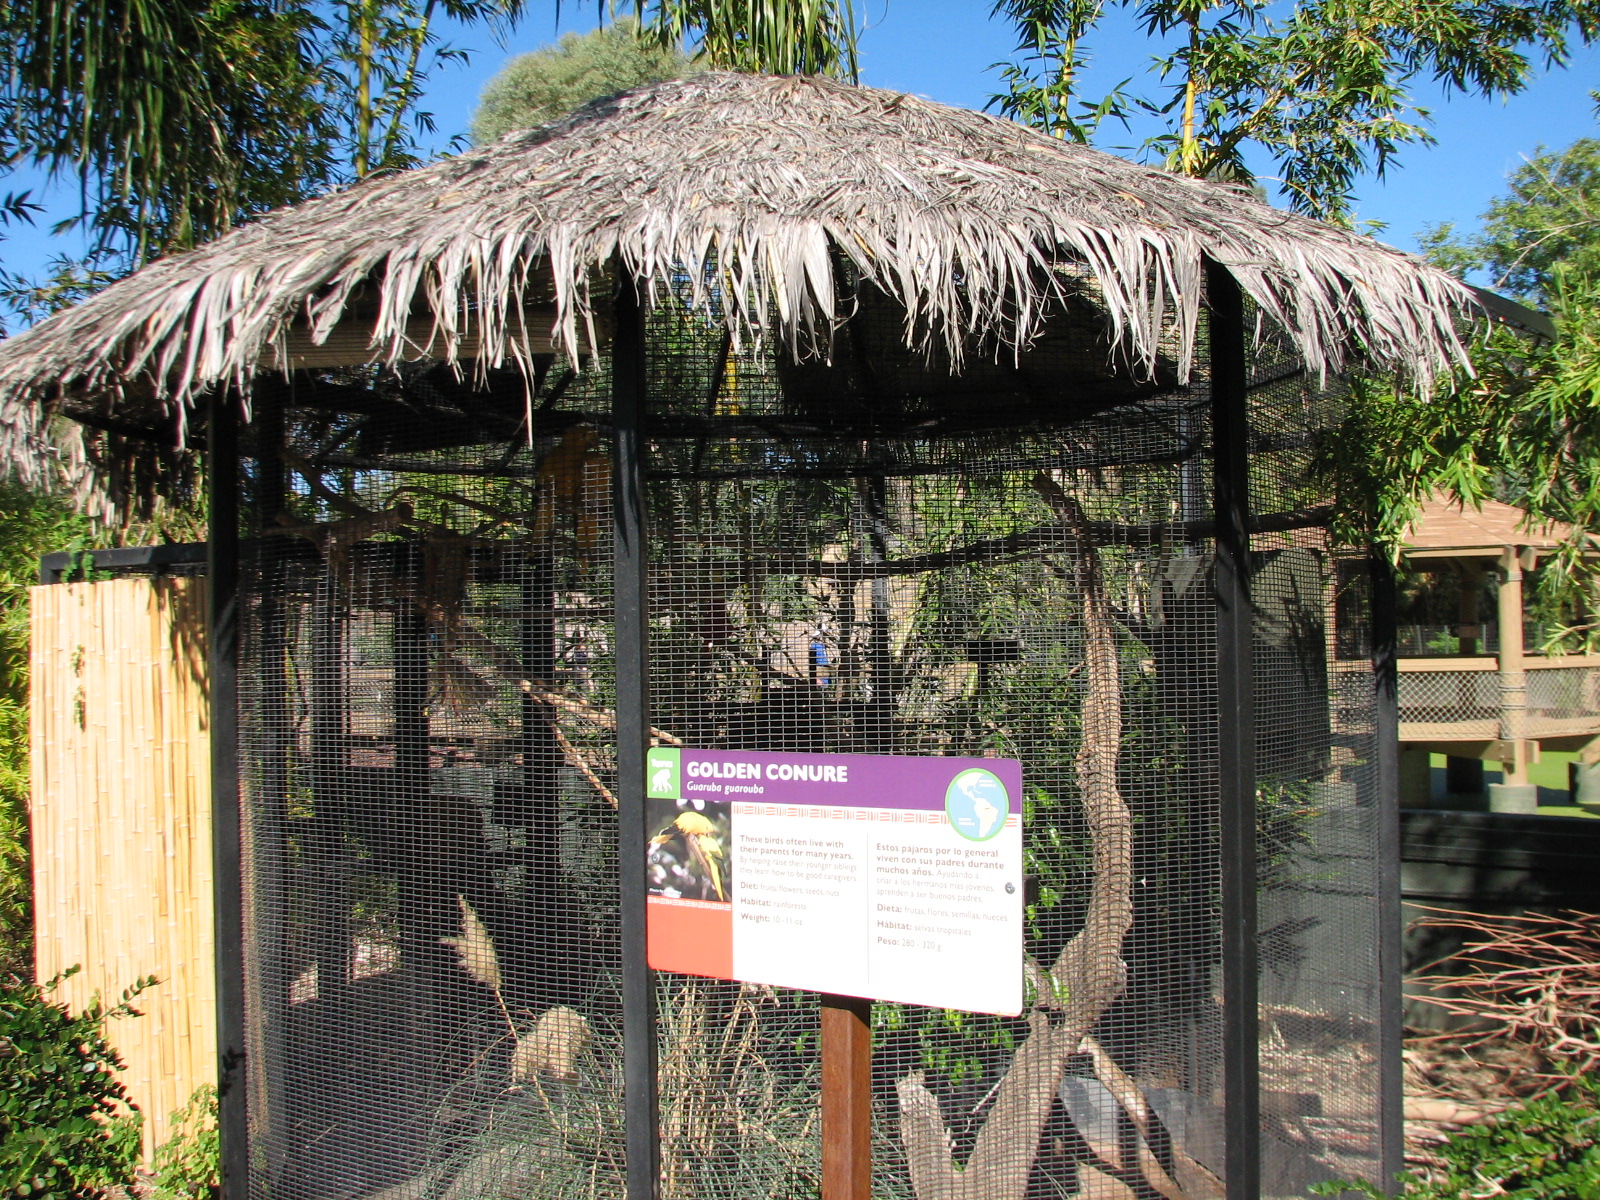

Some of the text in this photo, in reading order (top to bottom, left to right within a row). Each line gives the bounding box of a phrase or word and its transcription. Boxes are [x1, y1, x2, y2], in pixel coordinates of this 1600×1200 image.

[687, 761, 761, 779] GOLDEN
[766, 763, 848, 782] CONURE
[687, 781, 764, 795] Guaruba guarouba
[740, 835, 762, 843] These
[806, 851, 827, 859] many
[877, 843, 899, 852] Estos
[902, 845, 933, 854] pájaros
[936, 848, 951, 856] por
[965, 850, 998, 858] general
[740, 856, 747, 864] By
[749, 857, 770, 866] helping
[806, 862, 831, 871] younger
[834, 863, 857, 872] siblings
[936, 858, 965, 867] padres
[968, 860, 1004, 869] durante
[740, 867, 752, 875] they
[877, 866, 909, 875] muchos
[912, 867, 933, 876] años.
[936, 870, 972, 879] Ayudando
[913, 879, 947, 888] hermanos
[877, 888, 908, 896] aprenden
[930, 891, 955, 900] buenos
[741, 897, 806, 910] Habitat: rainforests
[877, 904, 902, 912] Dieta:
[741, 912, 770, 923] Weight:
[877, 920, 971, 936] Hábitat: selvas tropicales
[877, 936, 899, 946] Peso:
[902, 938, 914, 947] 280
[923, 940, 935, 949] 320
